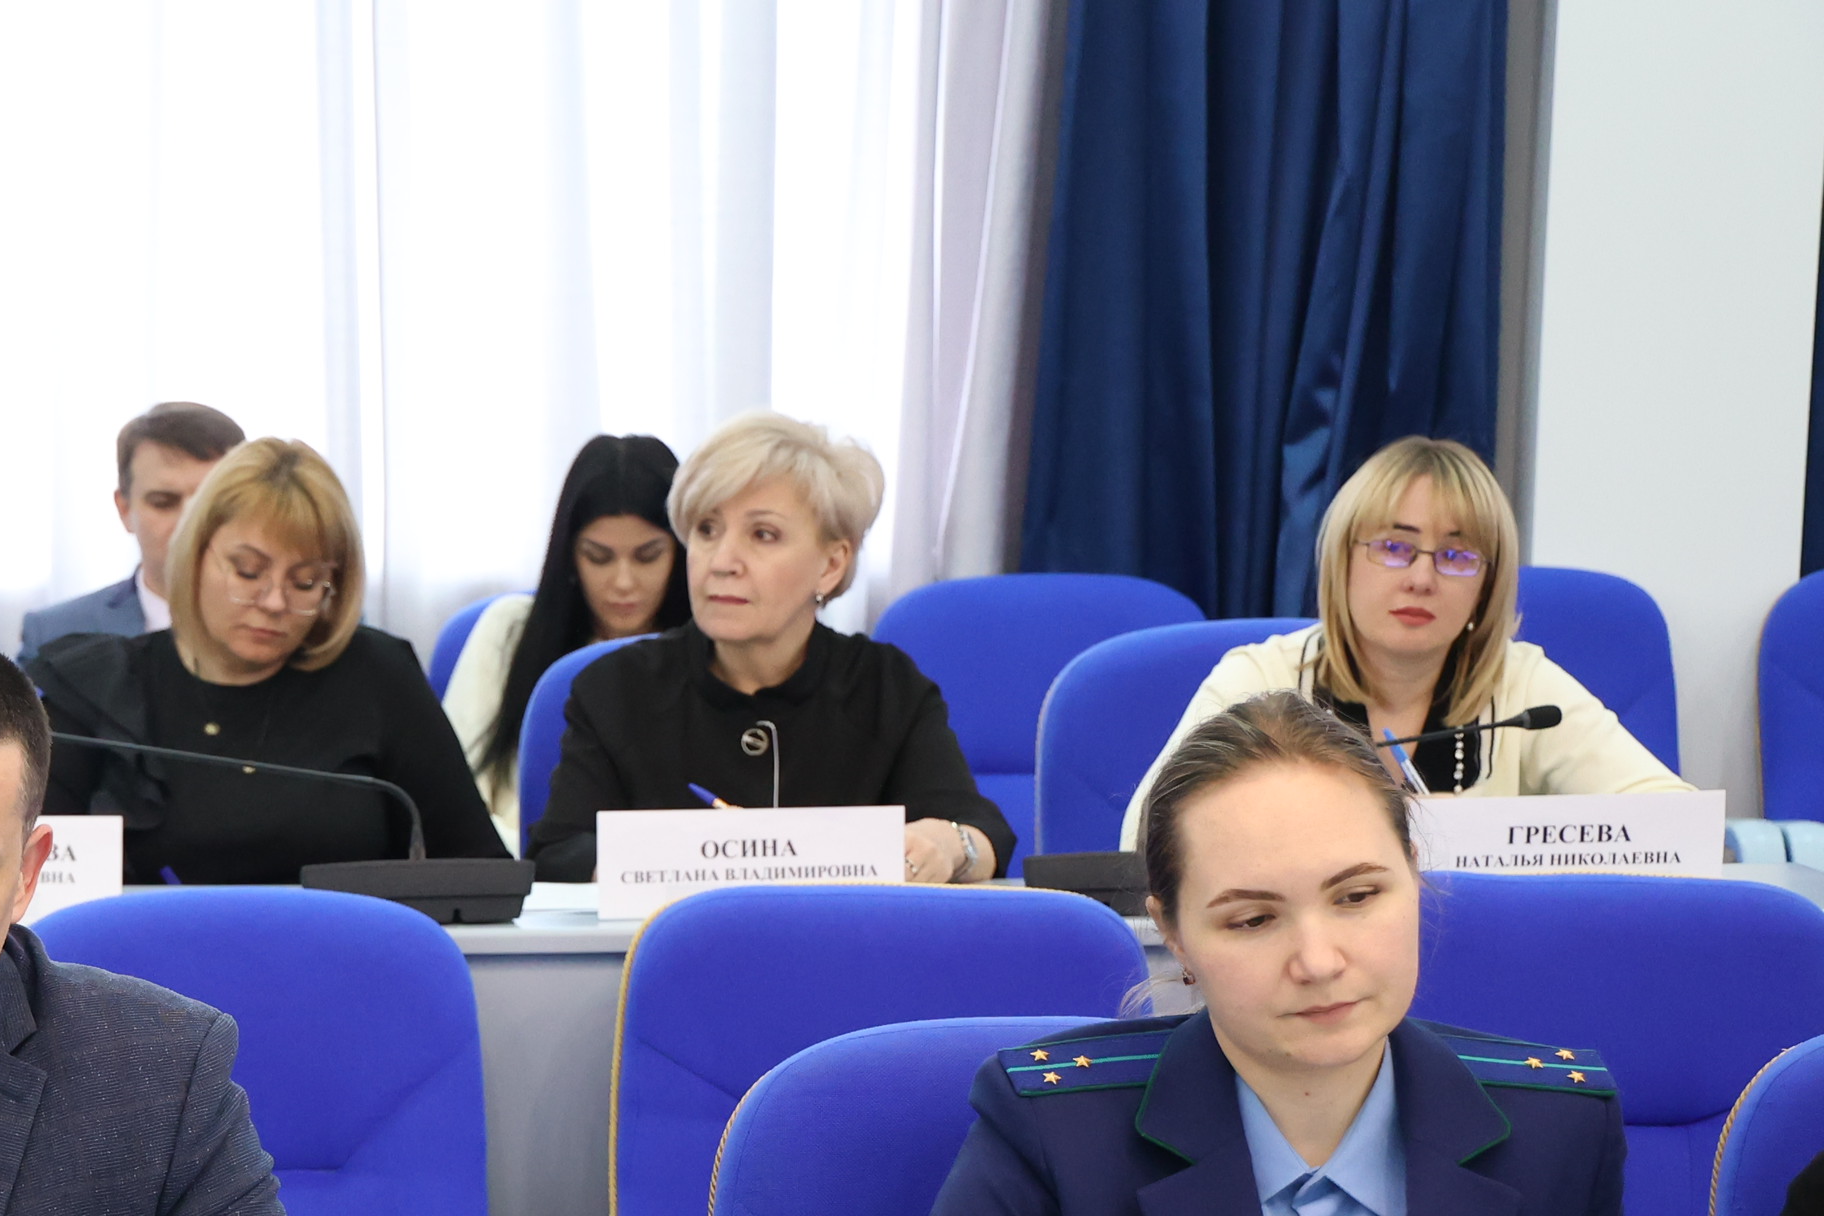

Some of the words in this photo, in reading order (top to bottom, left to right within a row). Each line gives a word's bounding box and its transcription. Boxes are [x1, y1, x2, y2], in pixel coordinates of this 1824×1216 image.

[1507, 823, 1632, 846] ГРЕСЕВА
[699, 837, 799, 860] ОСИНА
[1455, 853, 1544, 869] НАТАЛЬЯ
[1549, 850, 1682, 867] НИКОЛАЕВНА
[620, 868, 719, 885] СВЕТЛАНА
[724, 863, 879, 882] ВЛАДИМИРОВНА
